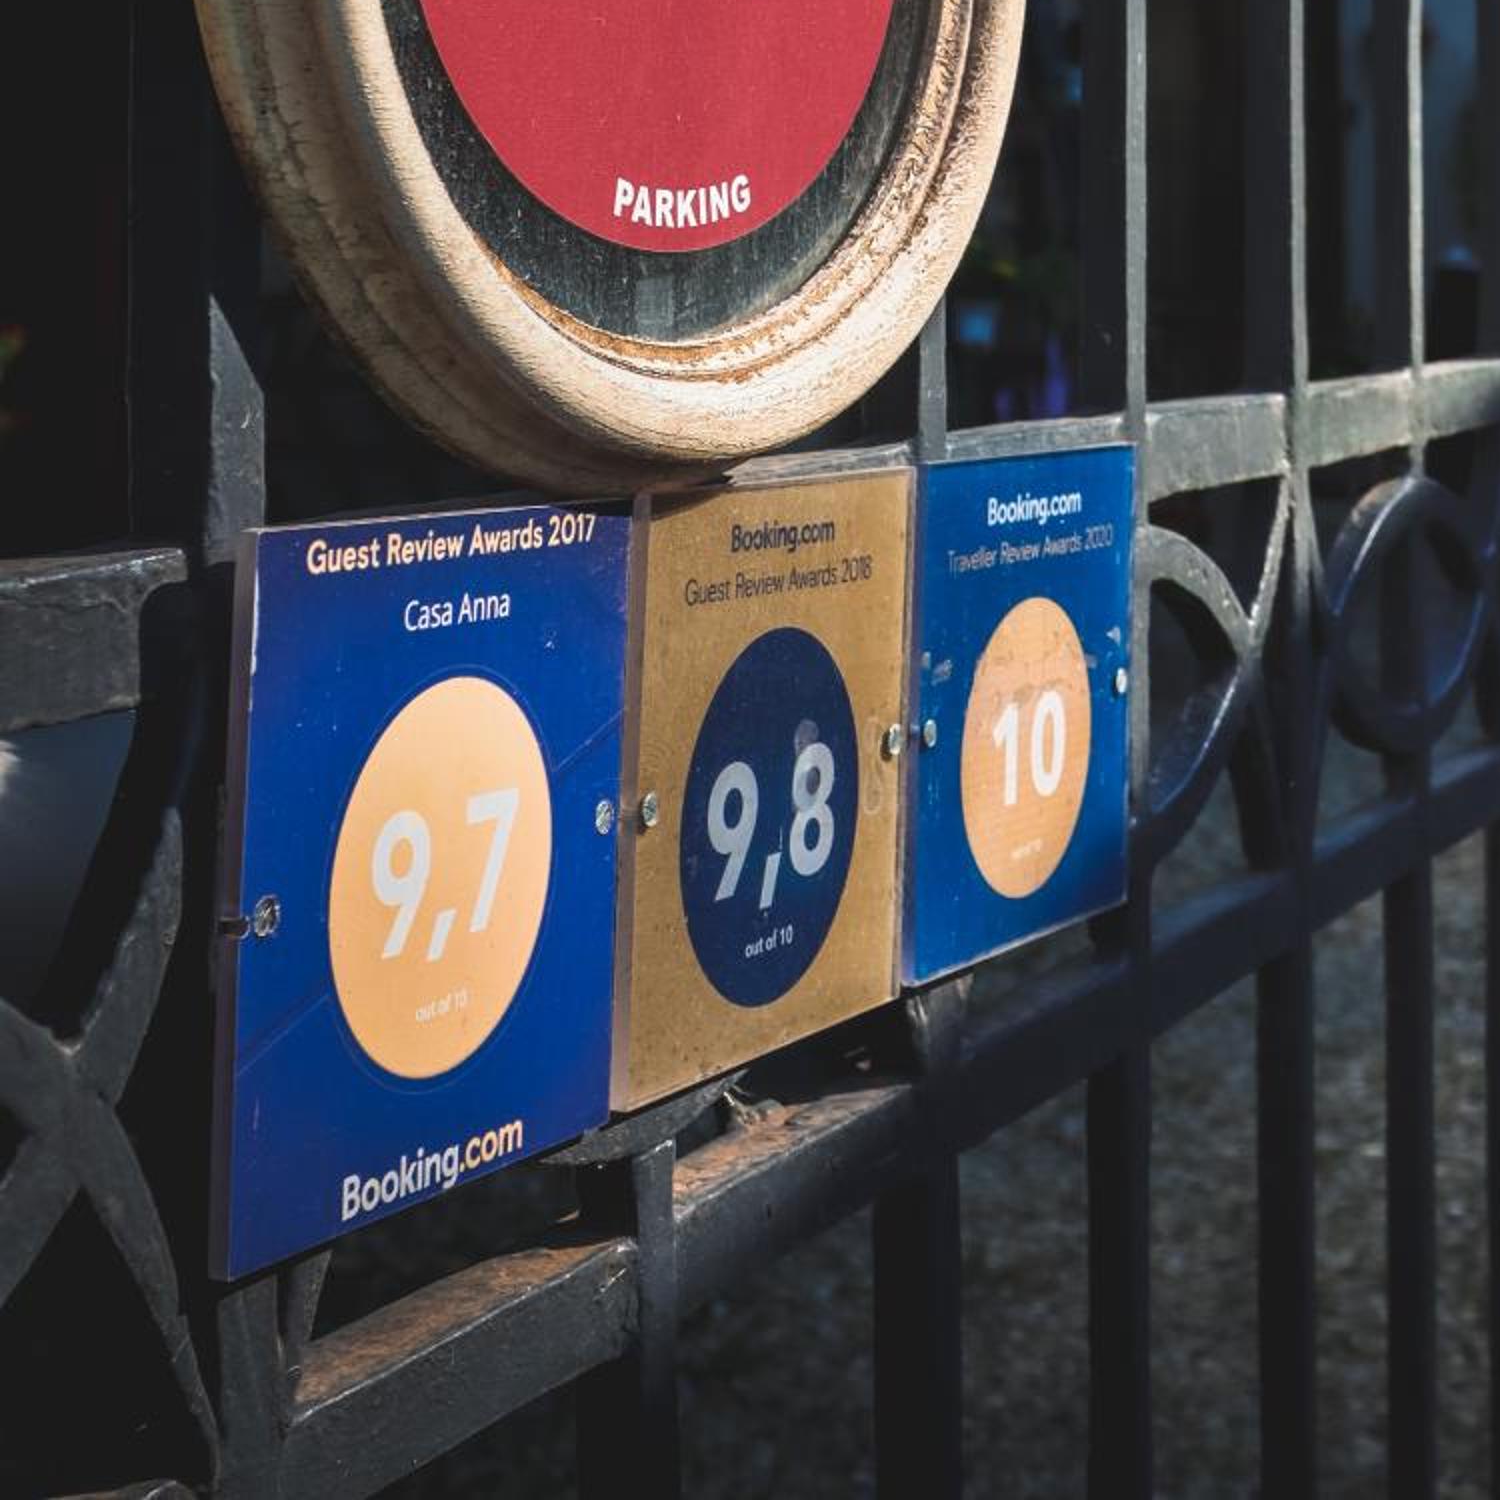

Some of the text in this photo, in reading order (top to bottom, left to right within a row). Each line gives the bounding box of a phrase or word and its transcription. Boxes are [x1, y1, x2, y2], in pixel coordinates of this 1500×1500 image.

[613, 174, 751, 228] PARKING
[987, 491, 1082, 526] Booking.com
[307, 513, 597, 575] Guest Review Awards 2017
[731, 520, 835, 553] Booking.com
[1001, 541, 1040, 565] Review
[1042, 531, 1082, 558] Awards
[685, 554, 873, 607] Guest Review Awards 2018
[404, 592, 511, 632] Casa Anna
[992, 690, 1066, 806] 10
[707, 742, 835, 910] 9,8
[371, 787, 520, 963] 9,7
[745, 924, 794, 959] out of 10
[341, 1118, 524, 1223] Booking.com
